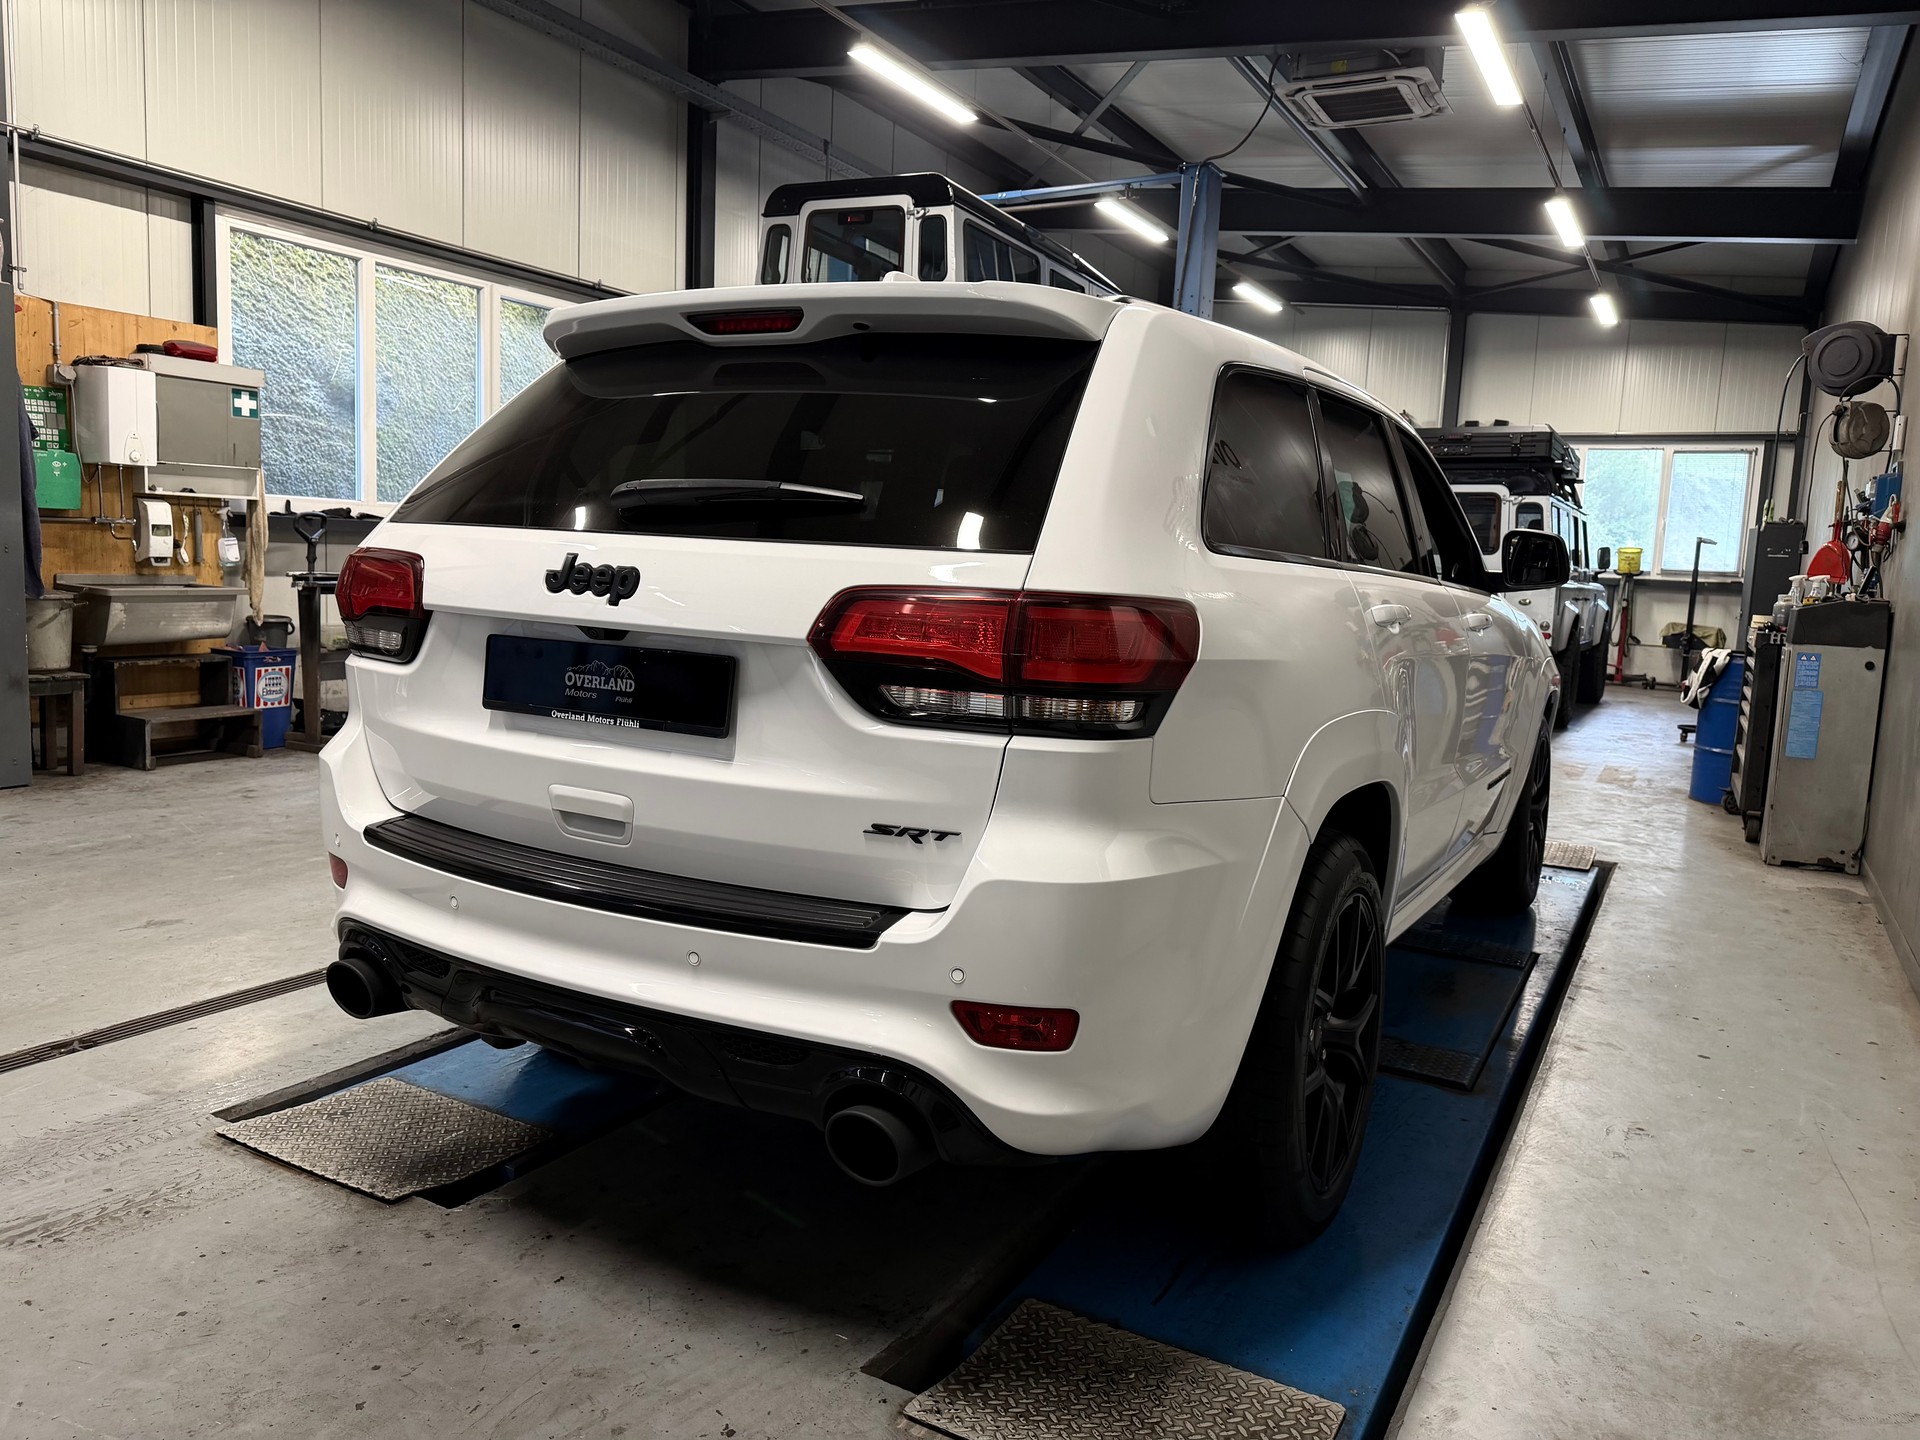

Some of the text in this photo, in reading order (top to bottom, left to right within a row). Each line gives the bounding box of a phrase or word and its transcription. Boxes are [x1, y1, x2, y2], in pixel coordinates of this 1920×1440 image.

[545, 552, 640, 606] Jeep
[265, 677, 282, 687] LUSSO
[565, 671, 635, 692] OVERLAND
[262, 688, 283, 696] Eldorado
[565, 688, 597, 698] Motors
[615, 695, 633, 703] Flühli
[551, 709, 640, 729] Overland Motors Flühli
[863, 823, 961, 844] SRT
